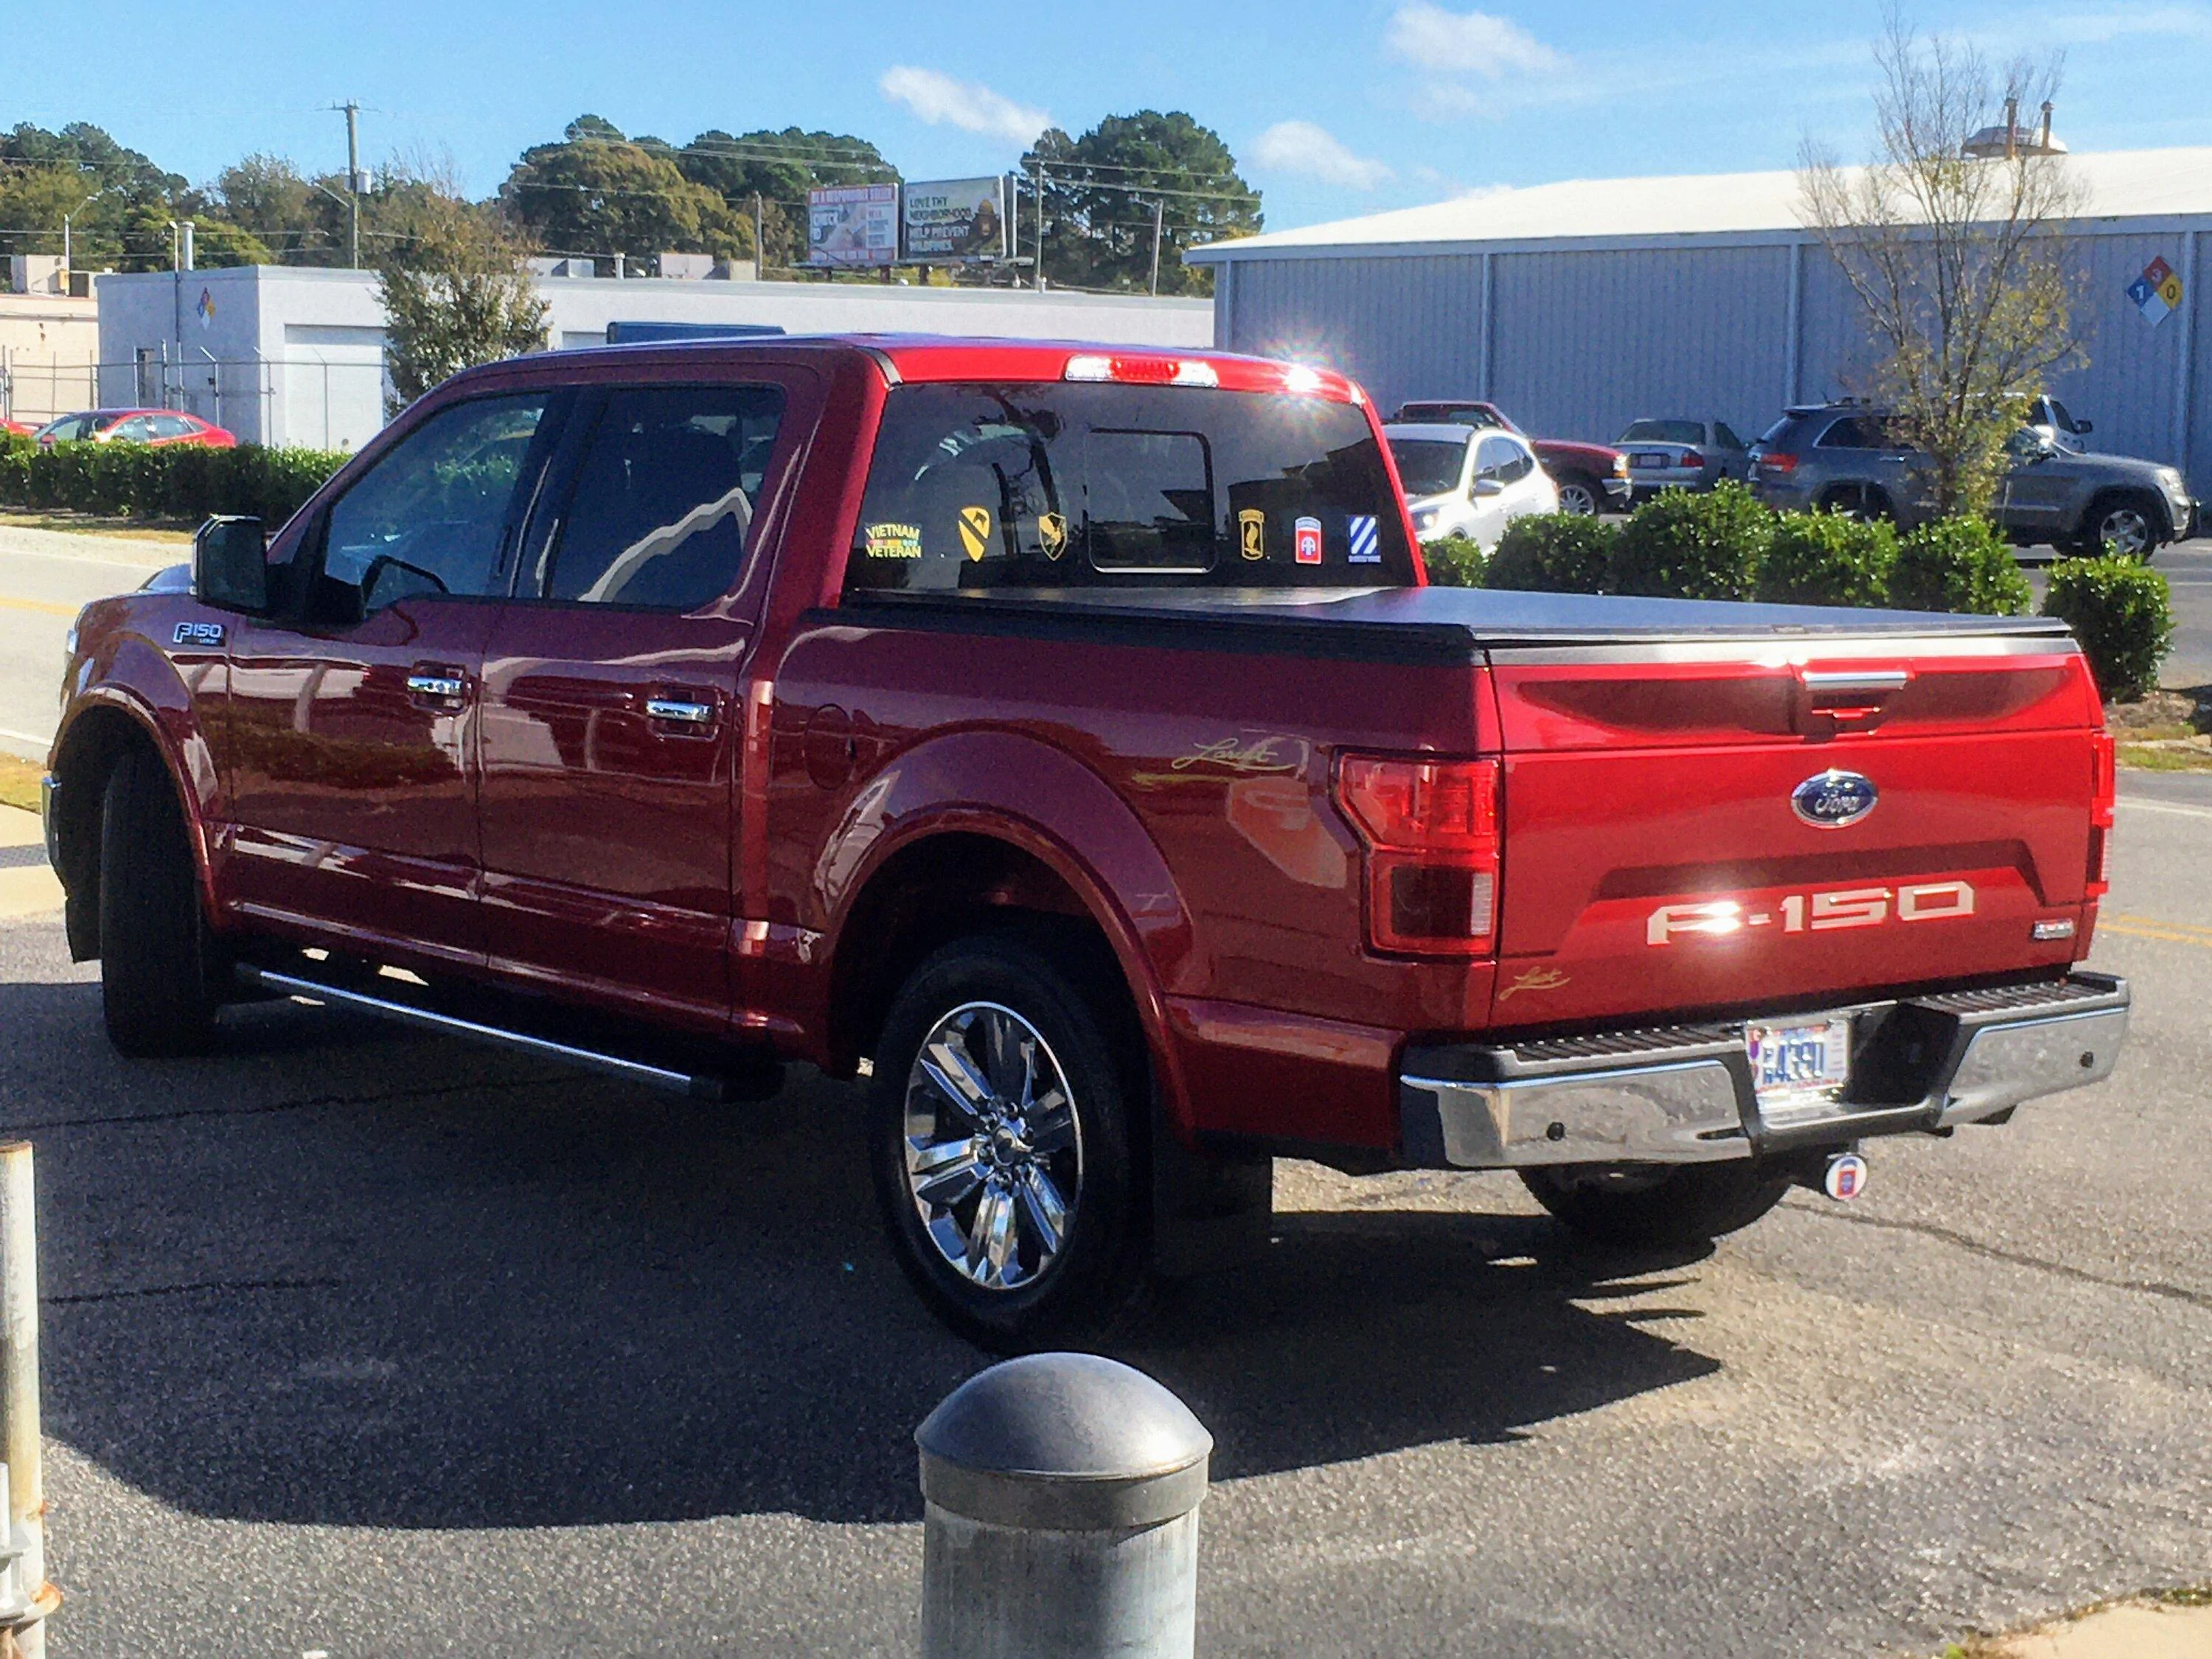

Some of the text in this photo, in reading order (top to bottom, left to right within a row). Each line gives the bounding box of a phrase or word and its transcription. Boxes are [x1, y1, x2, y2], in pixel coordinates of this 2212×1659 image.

[910, 197, 930, 208] LOVE
[2136, 285, 2144, 299] 1
[2166, 285, 2177, 299] 0
[866, 524, 920, 540] VIETNAM
[866, 544, 921, 558] VETERAN
[1814, 782, 1860, 815] Ford
[1647, 880, 1975, 946] F-150
